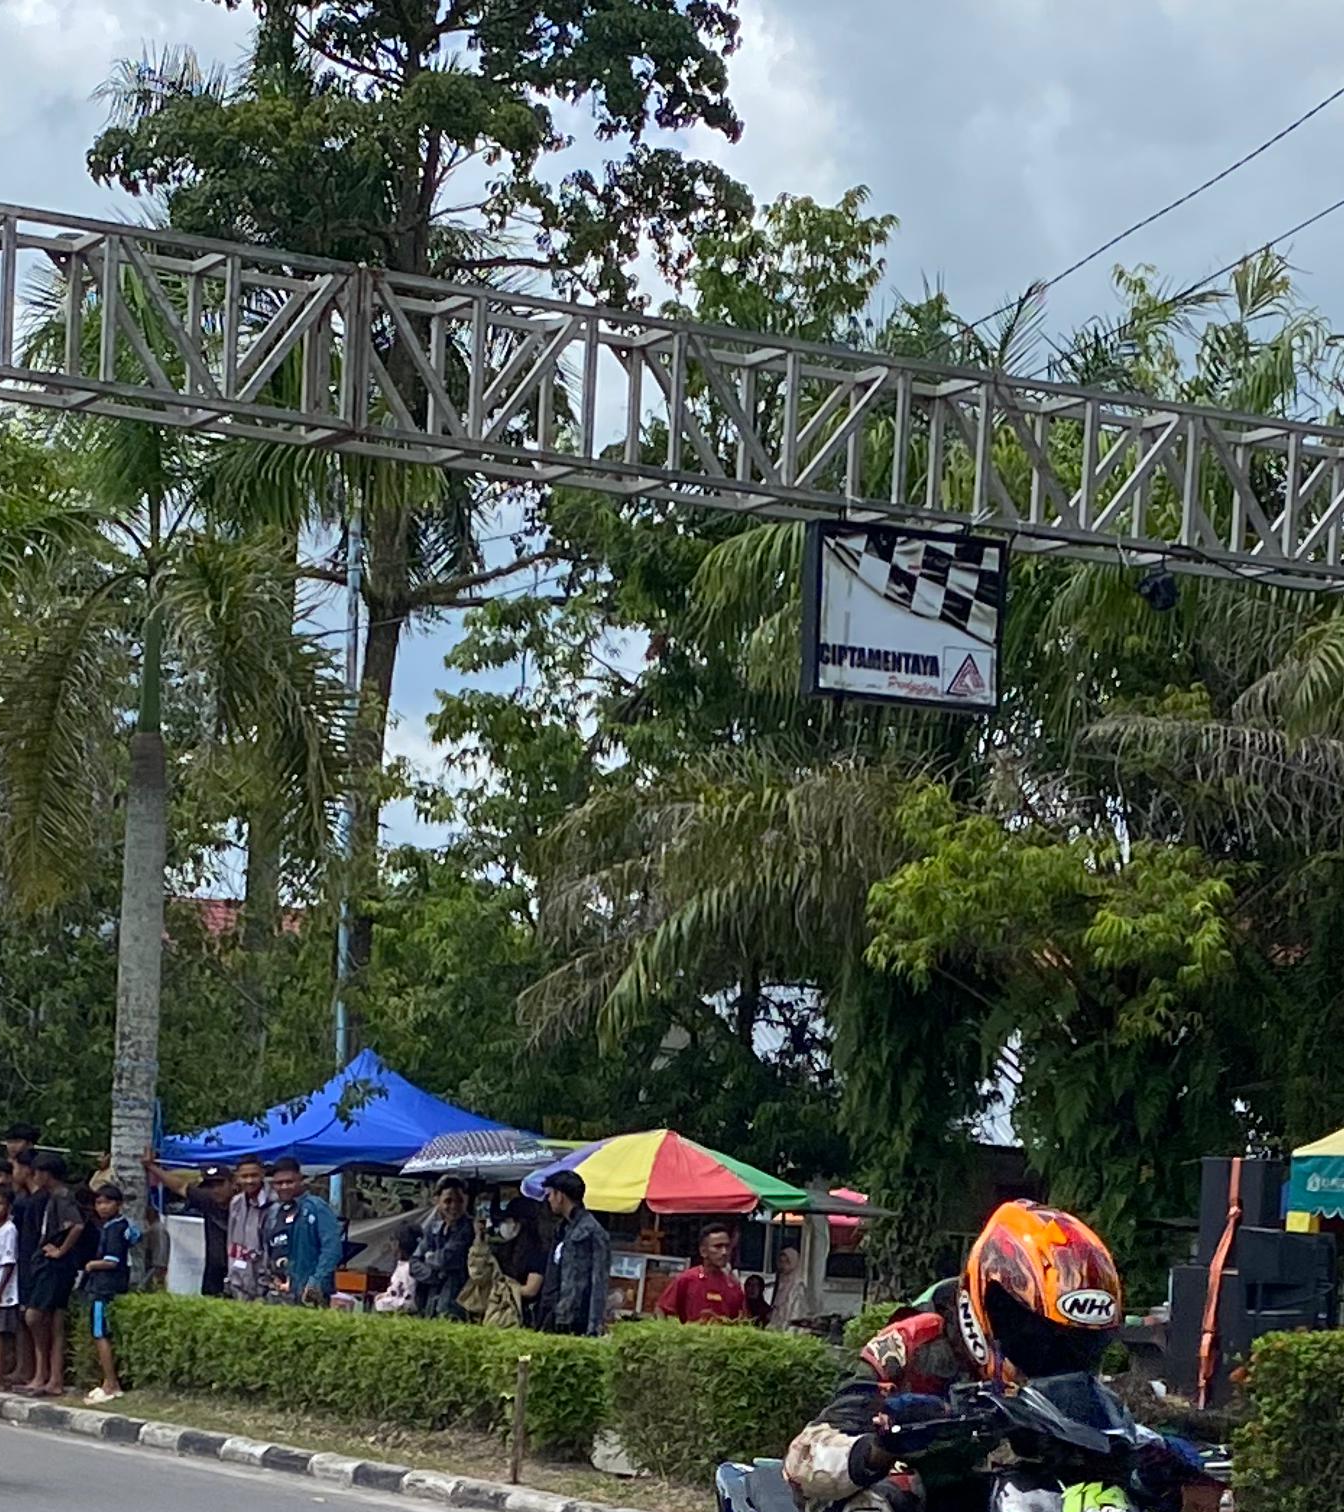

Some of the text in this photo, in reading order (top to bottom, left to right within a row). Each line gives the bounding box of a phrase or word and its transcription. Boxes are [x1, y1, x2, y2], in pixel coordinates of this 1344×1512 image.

[819, 642, 940, 678] CIPTAMENTAYA
[1067, 1296, 1115, 1317] NHK
[959, 1302, 985, 1352] NHK
